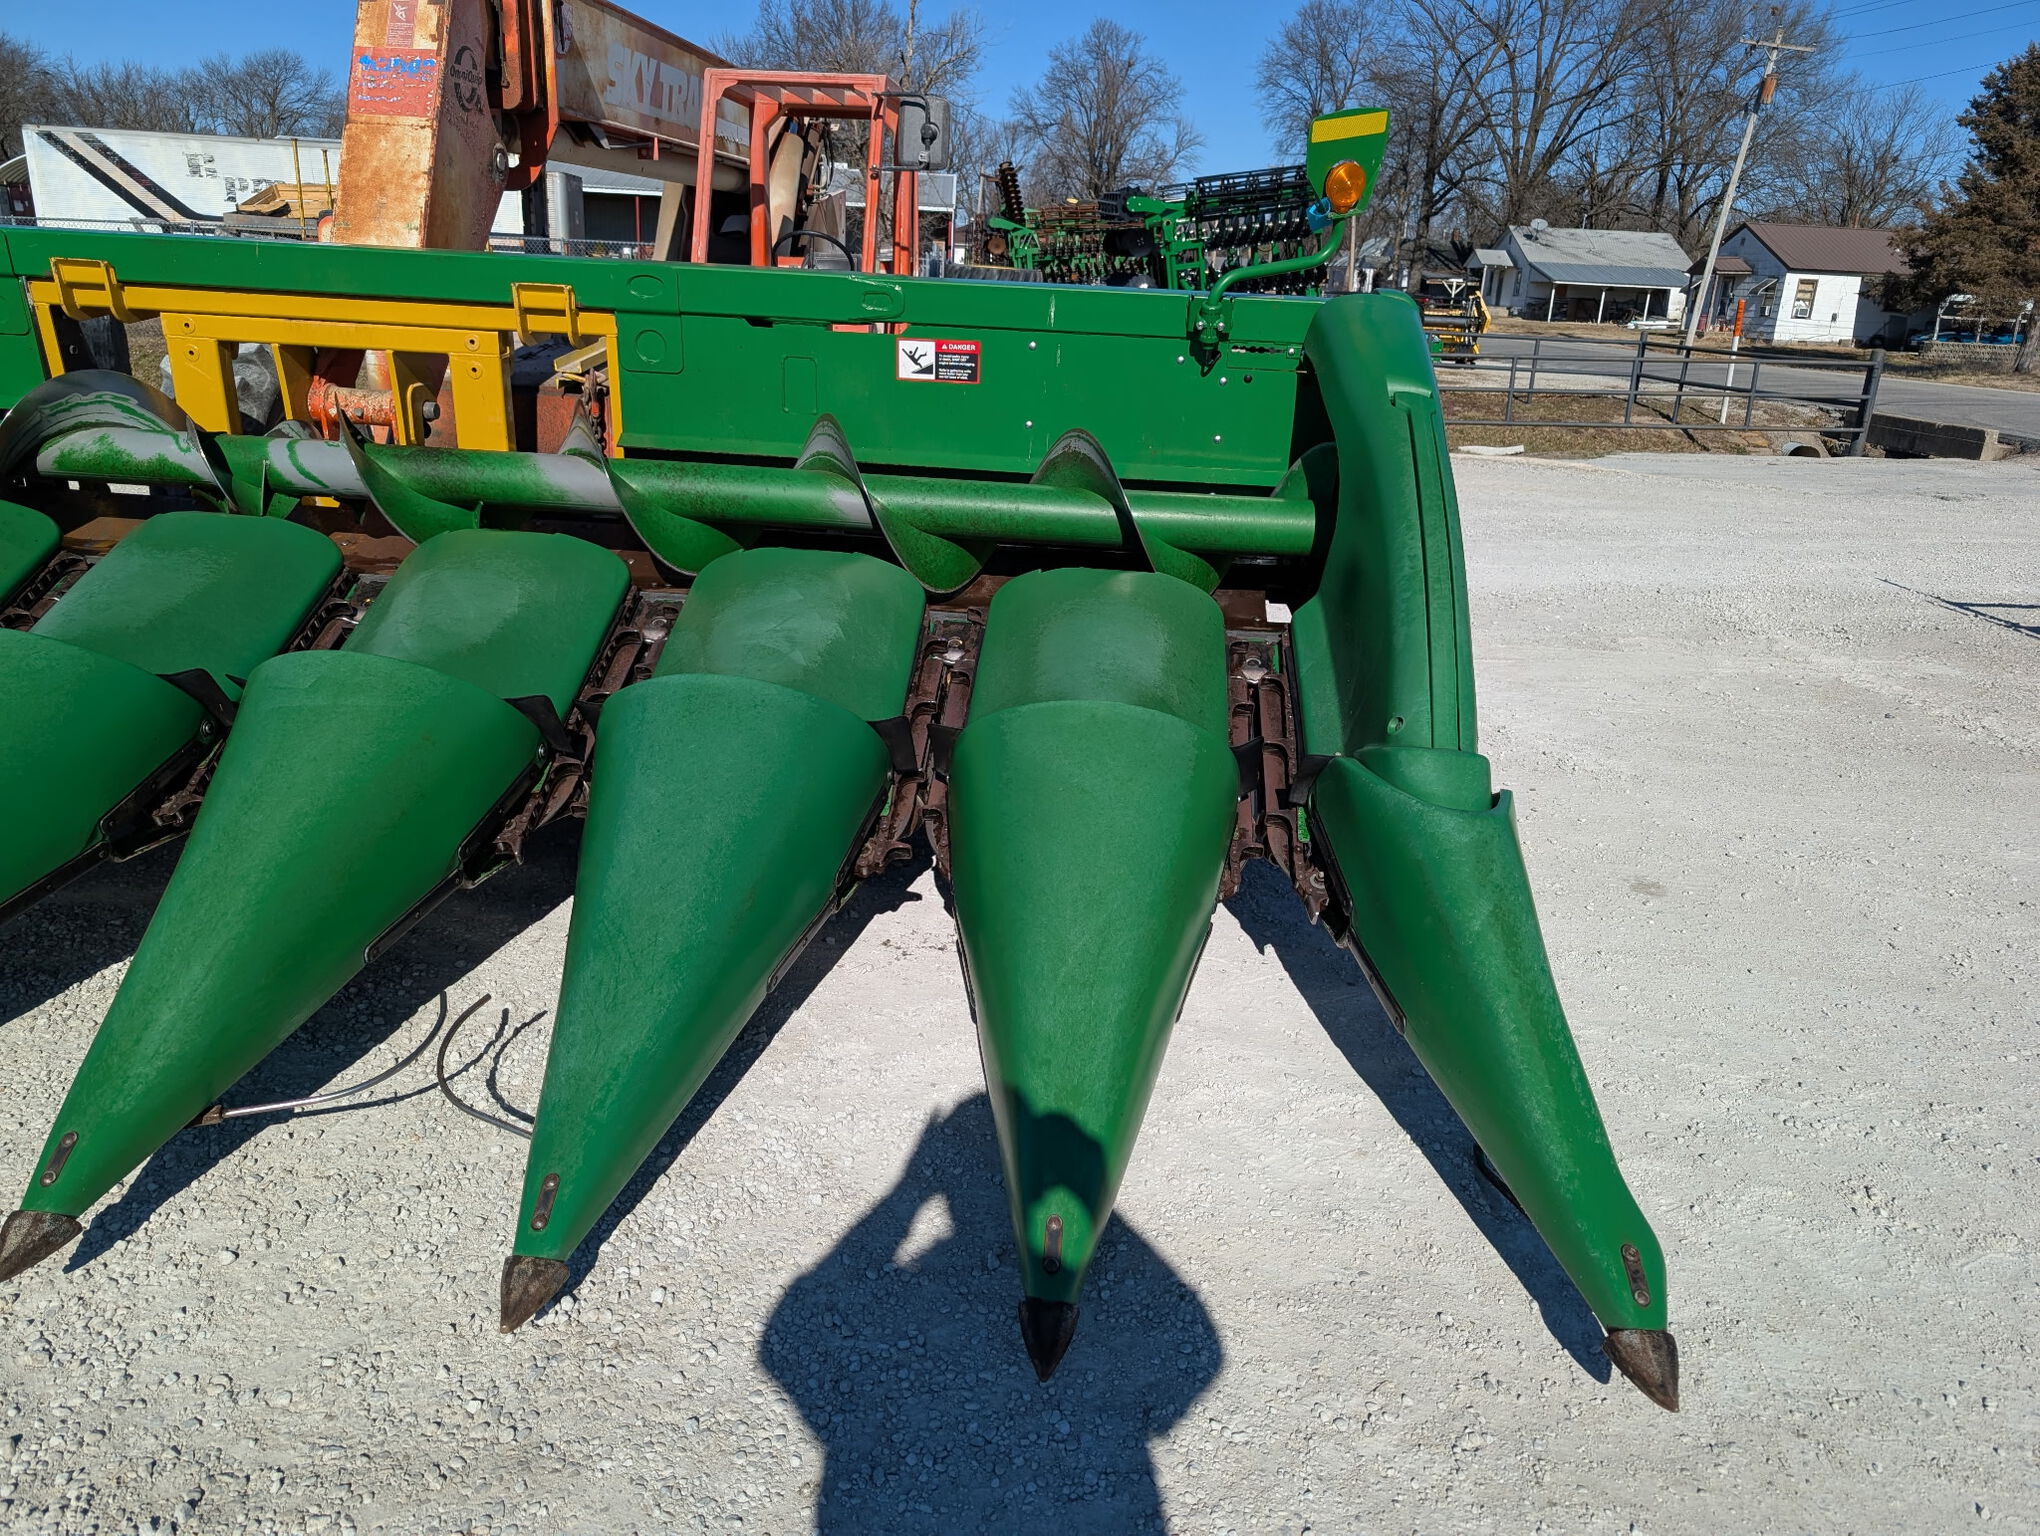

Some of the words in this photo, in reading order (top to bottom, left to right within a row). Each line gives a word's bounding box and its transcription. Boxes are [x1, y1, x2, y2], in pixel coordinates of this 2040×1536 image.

[604, 42, 660, 113] SKY
[658, 62, 703, 129] TRA
[948, 343, 976, 351] DANGER
